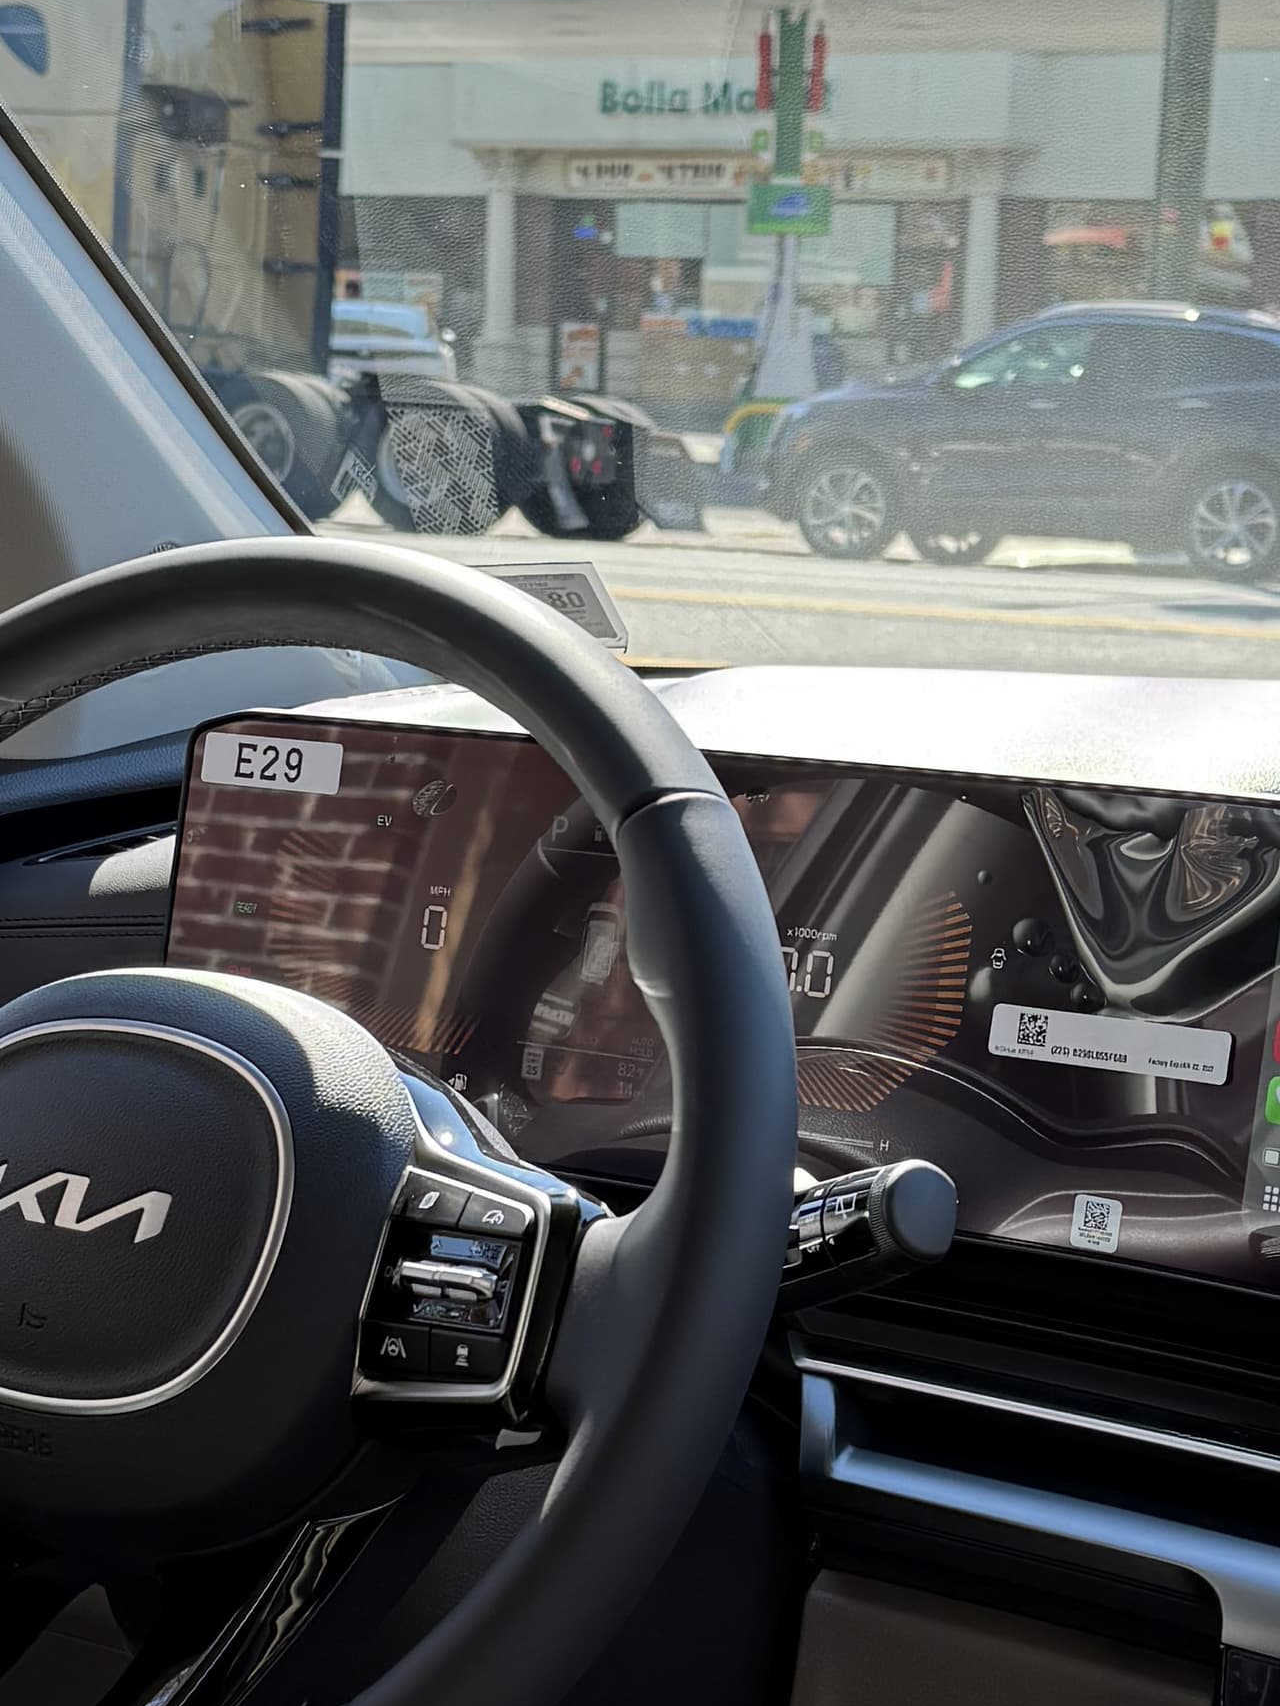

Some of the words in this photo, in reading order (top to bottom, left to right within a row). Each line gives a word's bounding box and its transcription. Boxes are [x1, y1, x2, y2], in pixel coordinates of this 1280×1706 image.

[600, 80, 690, 115] Bolla
[234, 743, 303, 783] E29
[377, 815, 392, 827] EV
[552, 815, 569, 842] P
[421, 905, 447, 950] 0
[879, 1139, 889, 1152] H
